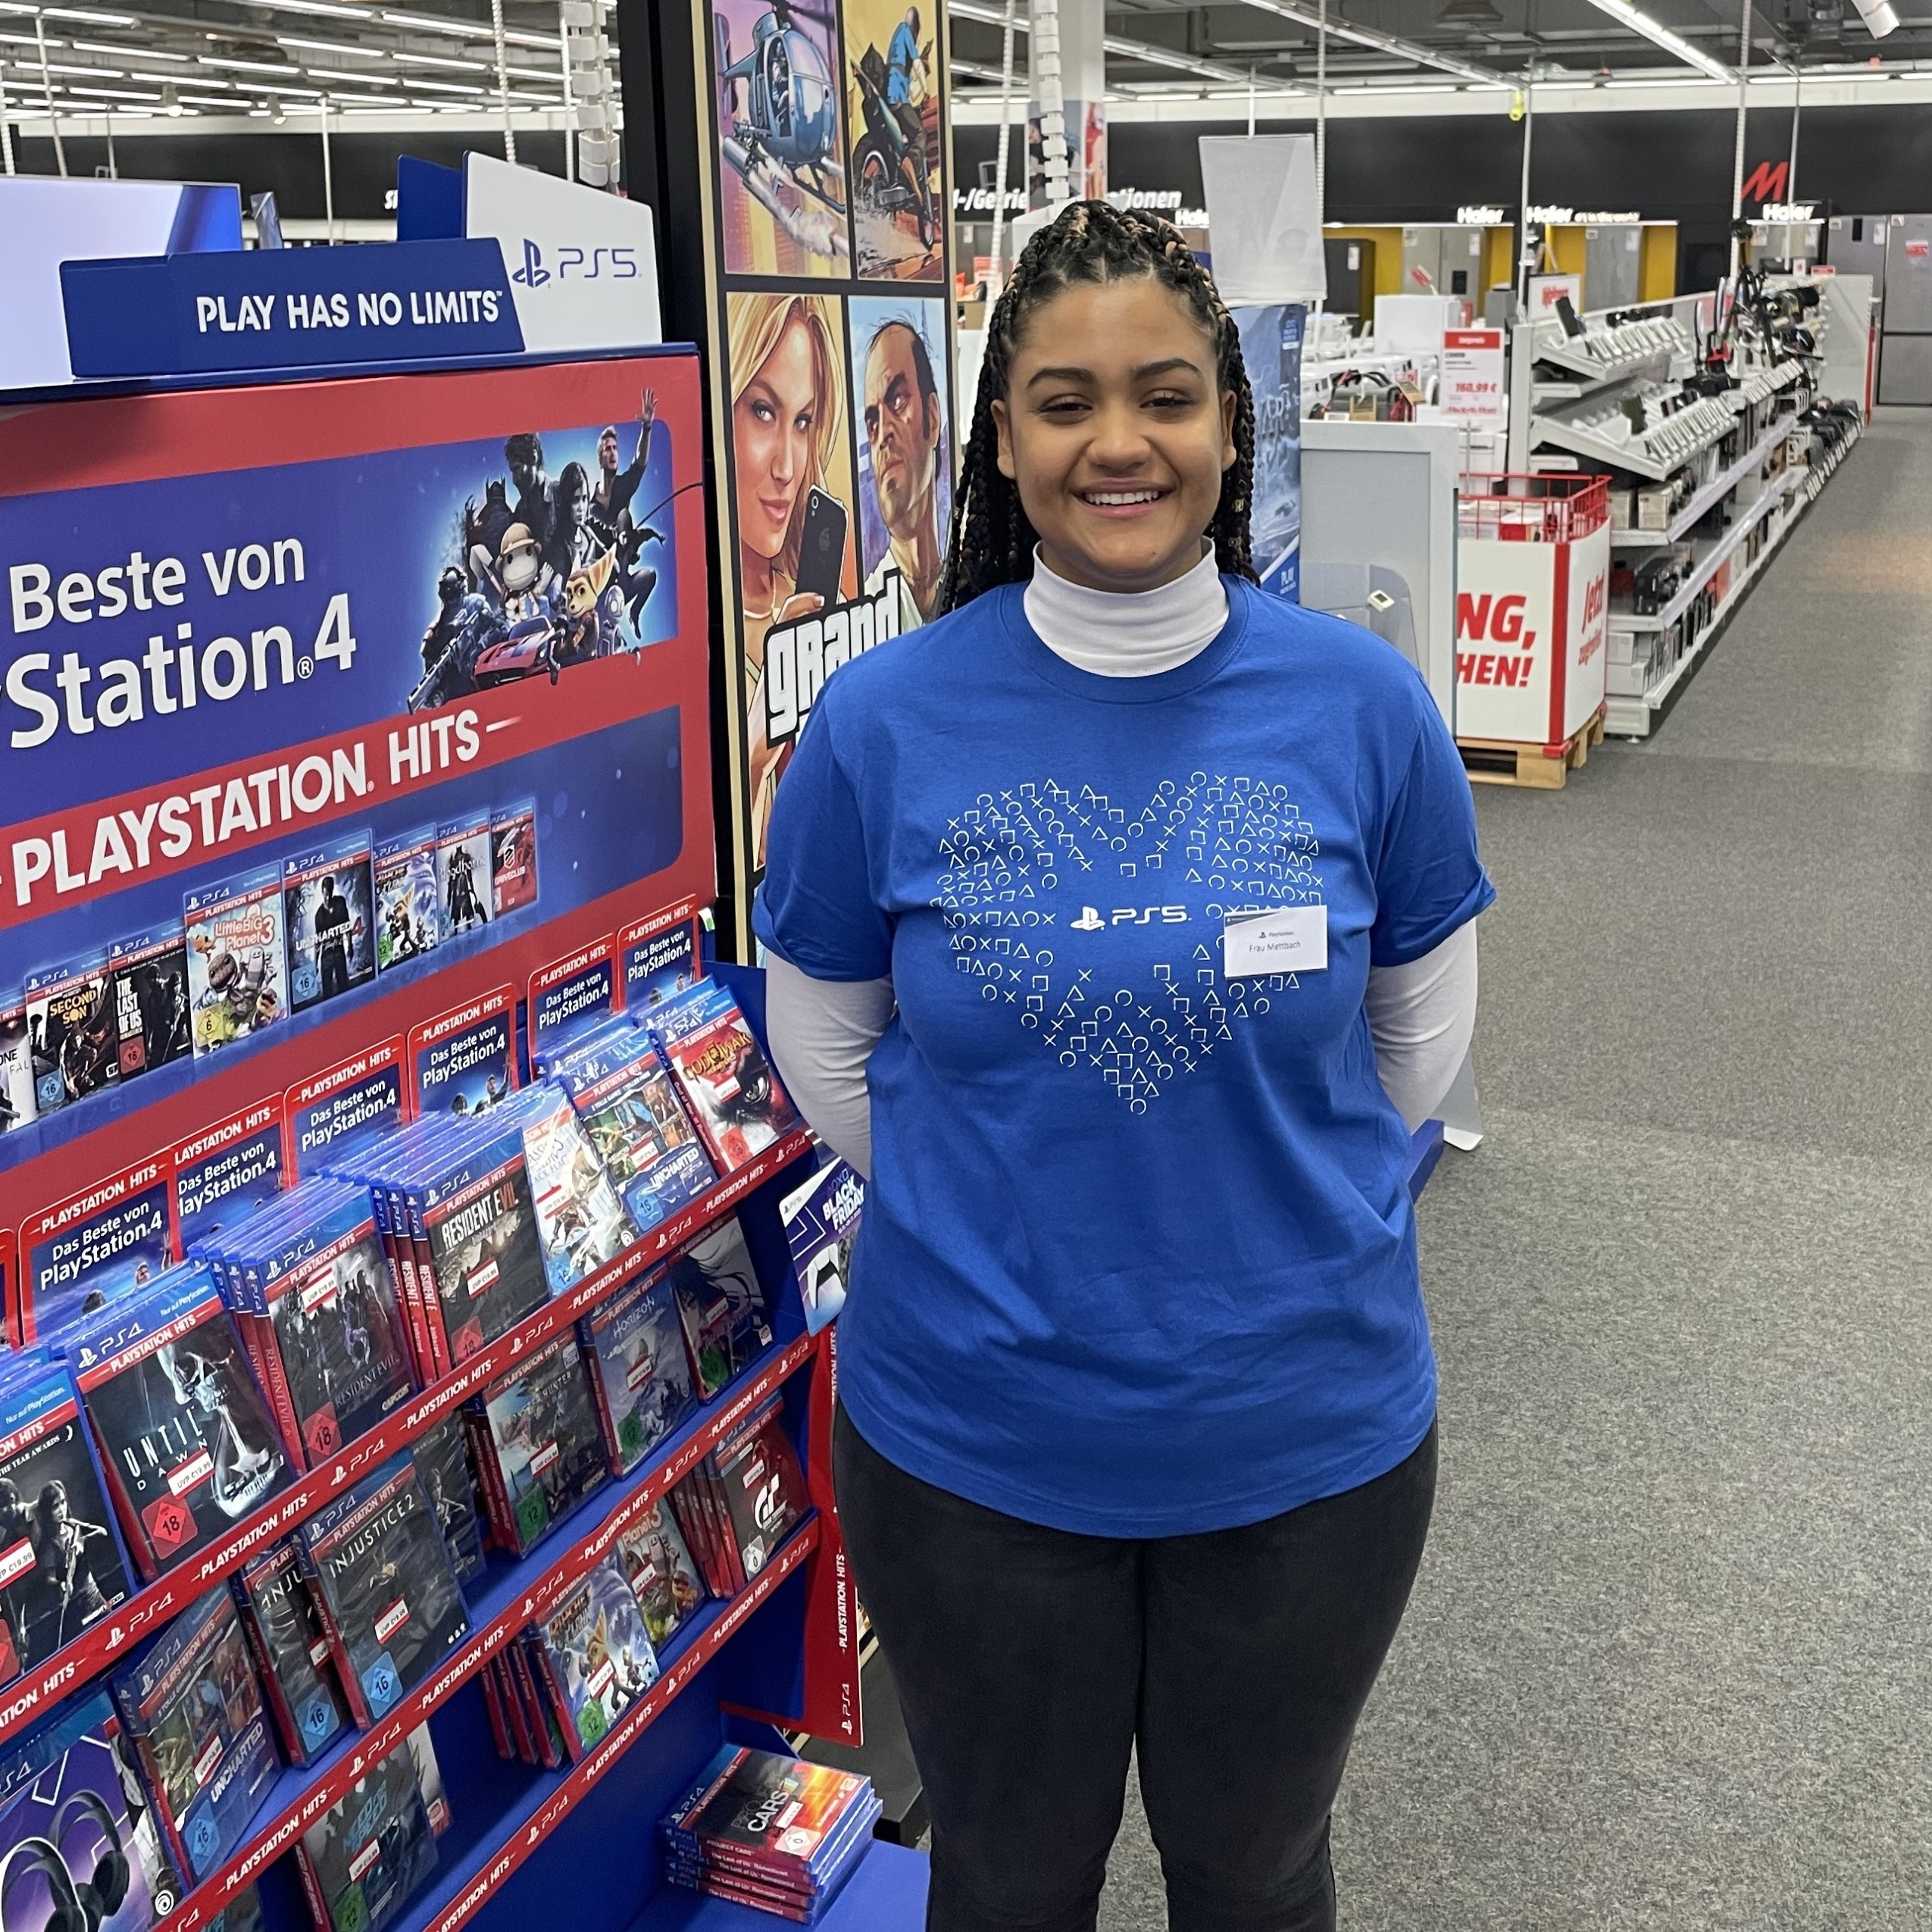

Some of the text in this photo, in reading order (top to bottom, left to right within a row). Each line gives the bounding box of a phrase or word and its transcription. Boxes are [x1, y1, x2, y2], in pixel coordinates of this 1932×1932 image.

[1457, 205, 1504, 224] Haier
[1526, 205, 1574, 223] Haier
[1763, 202, 1815, 220] Haier
[559, 248, 636, 279] PS5
[197, 295, 274, 333] PLAY
[288, 293, 349, 329] HAS
[360, 292, 402, 327] NO
[9, 538, 305, 633] Beste von
[12, 709, 480, 907] PLAYSTATION HITS
[299, 853, 325, 870] PS4
[202, 887, 230, 905] PS4
[628, 904, 689, 942] PLAYSTATION HITS
[1111, 906, 1188, 925] PS5
[124, 936, 150, 954] PS4
[633, 930, 684, 963] Das Beste von
[1267, 941, 1301, 951] Mettbach
[42, 969, 68, 985] PS4
[540, 945, 606, 986] PLAYSTATION HITS
[117, 977, 133, 999] THE
[300, 977, 309, 989] 16
[546, 973, 602, 1008] Das Beste von
[49, 989, 97, 1018] SECOND
[62, 1005, 88, 1025] SON
[117, 996, 138, 1016] LAST
[423, 995, 503, 1042] PLAYSTATION HITS
[119, 1018, 129, 1034] OF
[129, 1014, 142, 1030] US
[430, 1025, 497, 1066] Das Beste von
[45, 1083, 56, 1096] 16
[301, 1047, 391, 1102] PLAYSTATION HITS
[311, 1080, 386, 1127] Das Beste von
[174, 1107, 270, 1165] LAYSTATION HITS
[178, 1142, 264, 1196] Das Beste von
[442, 1171, 471, 1196] PS4
[650, 1147, 699, 1187] UNCHARTED
[41, 1164, 157, 1234] PLAYSTATION HITS
[446, 1168, 505, 1212] PLAYSTATION HITS
[822, 1175, 855, 1221] BLACK
[832, 1183, 864, 1230] FRIDAY
[52, 1202, 149, 1261] Das Beste von
[441, 1194, 492, 1250] RESIDENT
[668, 1216, 692, 1240] PS4
[283, 1239, 315, 1268] PS4
[289, 1234, 356, 1284] PLAYSTATION HITS
[572, 1254, 642, 1309] PLAYSTATION HITS
[526, 1316, 554, 1343] PS4
[612, 1294, 655, 1340] HORIZON
[99, 1322, 144, 1355] PS4
[111, 1315, 196, 1373] PLAYSTATION HITS
[266, 1349, 283, 1400] RESIDENT
[334, 1370, 377, 1408] RESIDENT
[407, 1376, 468, 1430] PLAYSTATION
[471, 1359, 492, 1382] HITS
[18, 1421, 45, 1445] HITS
[123, 1408, 204, 1478] UNTIL
[315, 1426, 332, 1452] 18
[12, 1452, 31, 1468] YEAR
[350, 1438, 385, 1471] PS4
[674, 1445, 699, 1471] PS4
[380, 1482, 395, 1501] HITS
[632, 1488, 650, 1512] HITS
[162, 1515, 180, 1537] 18
[327, 1494, 358, 1527] PS4
[201, 1493, 308, 1580] PLAYSTATION HITS
[329, 1502, 406, 1579] INJUSTICE
[790, 1538, 809, 1563] PS4
[536, 1570, 564, 1602] PS4
[755, 1579, 771, 1601] HITS
[130, 1592, 174, 1632] PS4
[838, 1581, 848, 1649] PLAYSTATION
[153, 1637, 181, 1678] PS4
[422, 1626, 505, 1709] PLAYSTATION HITS
[677, 1652, 701, 1682] PS4
[43, 1661, 76, 1696] HITS
[375, 1675, 389, 1696] 16
[842, 1682, 850, 1717] PS4
[310, 1708, 325, 1728] 16
[587, 1717, 598, 1734] 12
[367, 1722, 402, 1761] PS4
[586, 1702, 653, 1780] PLAYSTATION HITS
[210, 1721, 264, 1802] UNCHARTED
[542, 1795, 568, 1829] PS4
[682, 1787, 705, 1812] PS4
[747, 1790, 789, 1833] CARS
[197, 1827, 209, 1847] 16
[227, 1815, 300, 1891] PLAYSTATION
[302, 1789, 327, 1821] HITS
[436, 1855, 510, 1932] AYSTATION HITS
